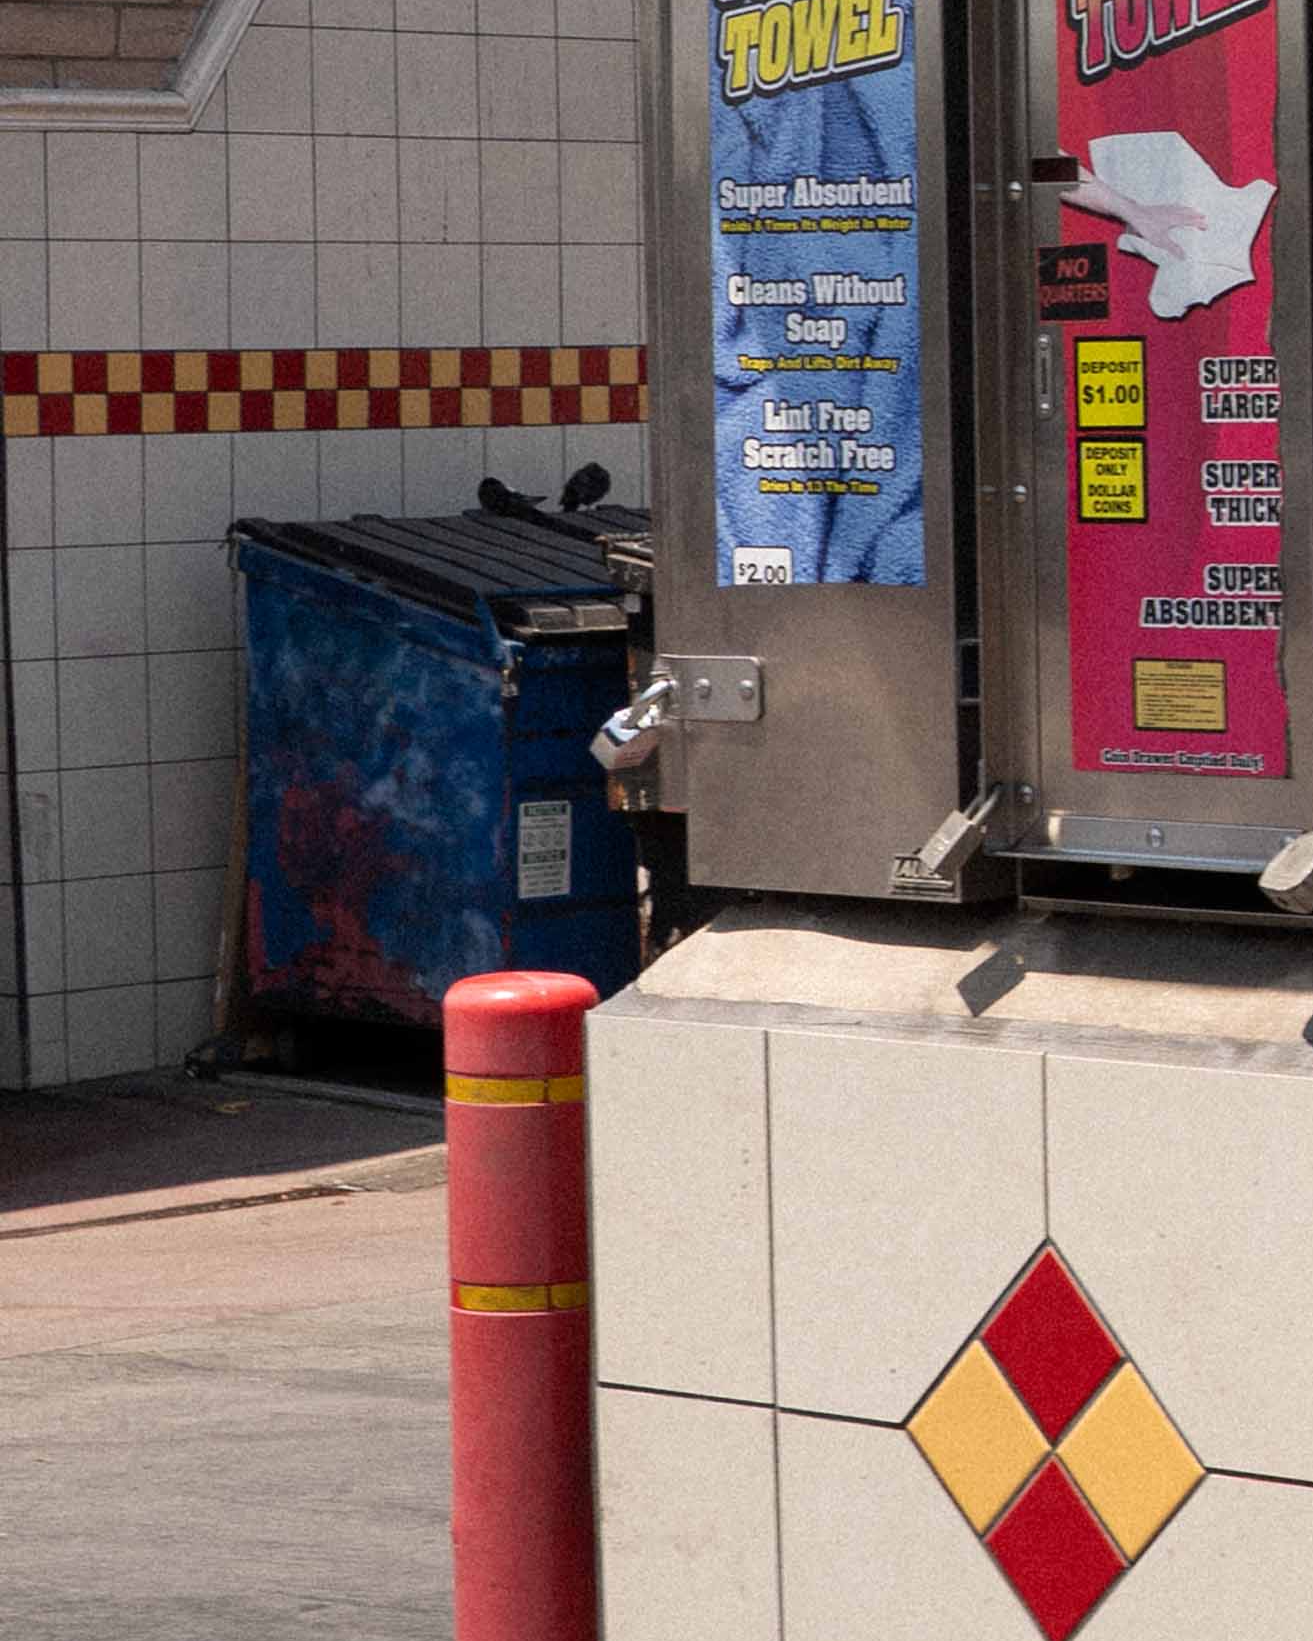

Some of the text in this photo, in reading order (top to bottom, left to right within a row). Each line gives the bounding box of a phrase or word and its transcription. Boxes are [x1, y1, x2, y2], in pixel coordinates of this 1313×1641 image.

[719, 175, 912, 215] Super Absorbent
[1055, 257, 1089, 280] NO
[727, 272, 905, 306] Cleans Without
[1041, 282, 1108, 306] QUARTERS
[785, 312, 846, 349] Soap
[1081, 361, 1140, 375] DEPOSIT
[1202, 358, 1278, 386] SUPER
[1082, 384, 1141, 405] $1.00
[1205, 392, 1280, 420] LARGE
[763, 400, 872, 432] Lint Free
[743, 438, 895, 470] Scratch Free
[1085, 446, 1137, 460] DEPOSIT
[1095, 463, 1127, 477] ONLY
[1204, 462, 1281, 489] SUPER
[1087, 484, 1137, 498] DOLLAR
[1092, 500, 1132, 514] COINS
[1210, 496, 1281, 523] THICK
[738, 562, 787, 584] $2.00
[1207, 565, 1282, 592] SUPER
[1142, 598, 1282, 626] ABSORBENT
